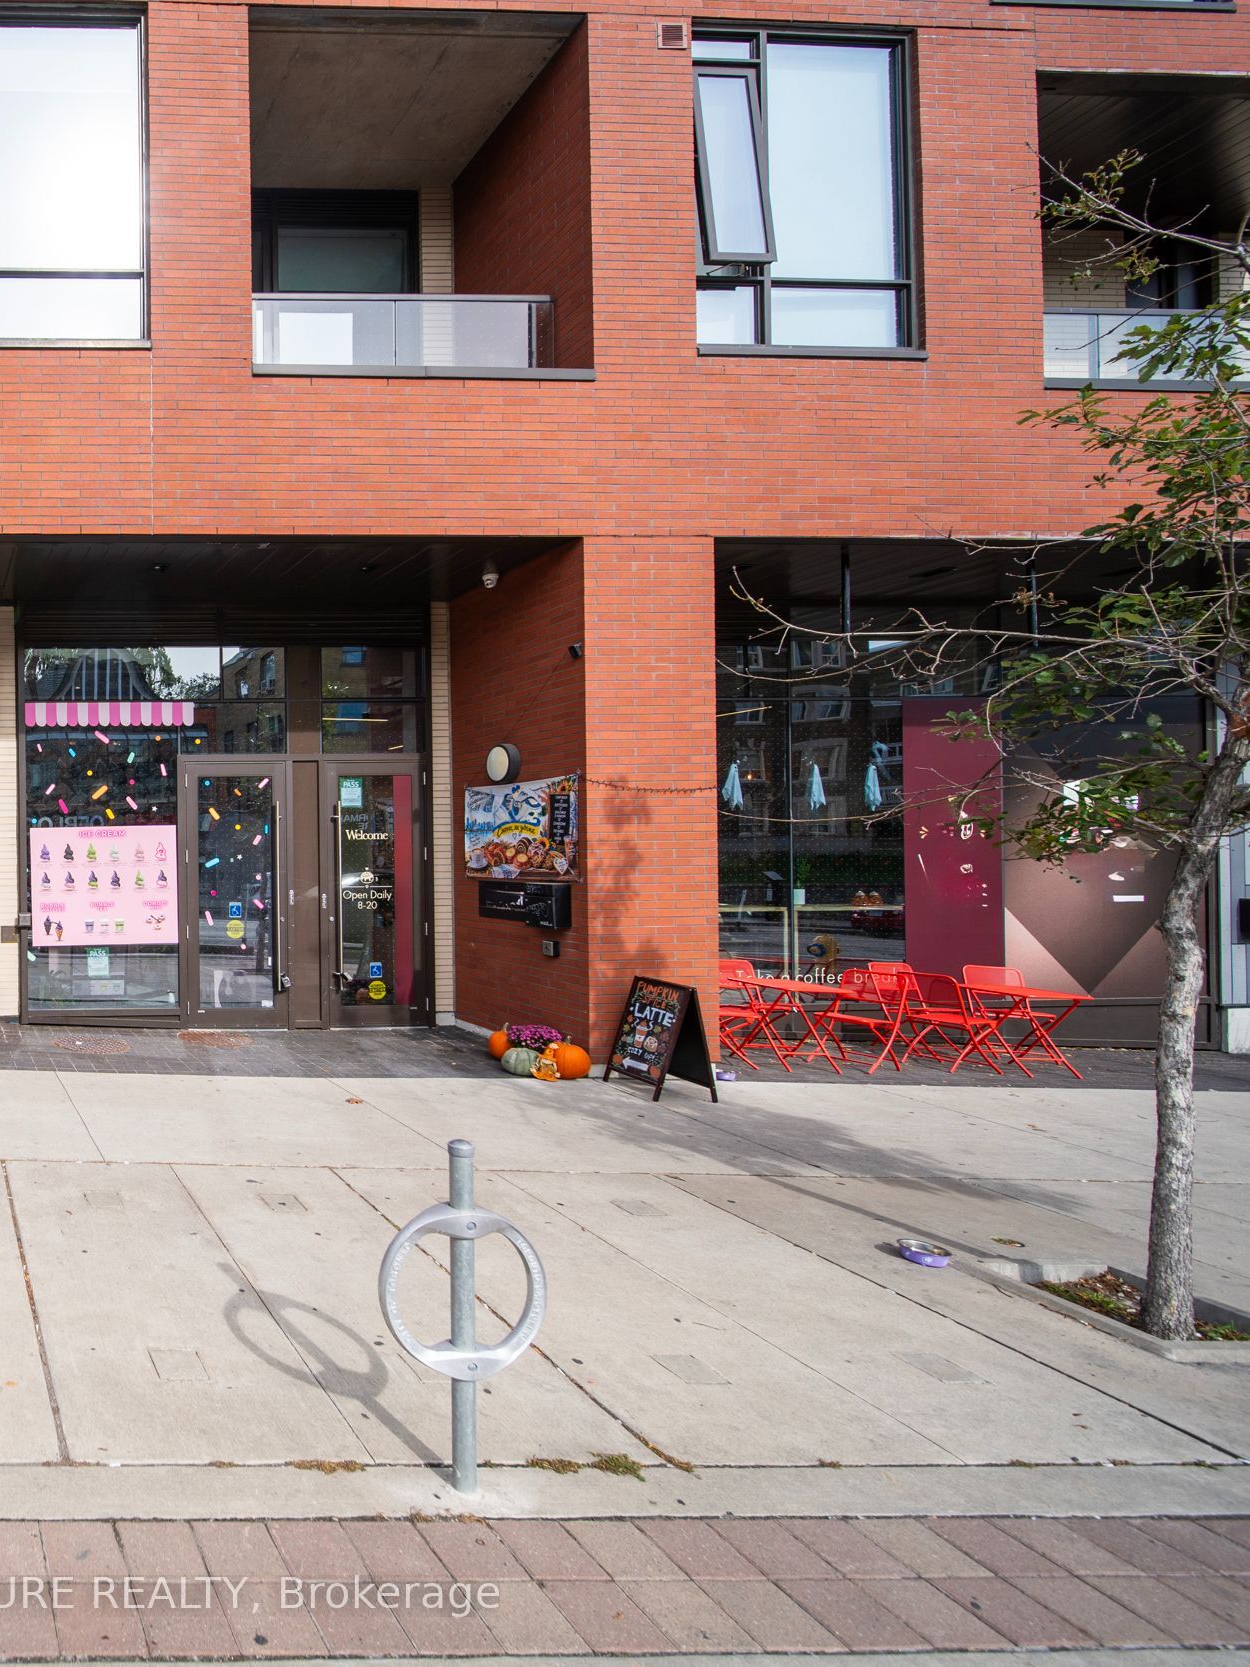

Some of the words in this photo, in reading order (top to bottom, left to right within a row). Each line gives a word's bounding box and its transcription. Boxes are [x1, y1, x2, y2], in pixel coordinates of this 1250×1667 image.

[95, 829, 127, 838] CREAM
[345, 829, 389, 840] Welcome
[342, 889, 368, 902] Open
[370, 889, 392, 902] Daily
[357, 900, 378, 910] 8-20
[795, 967, 844, 984] coffee
[636, 980, 680, 1001] PUMPKIN
[633, 1002, 674, 1027] LATTE
